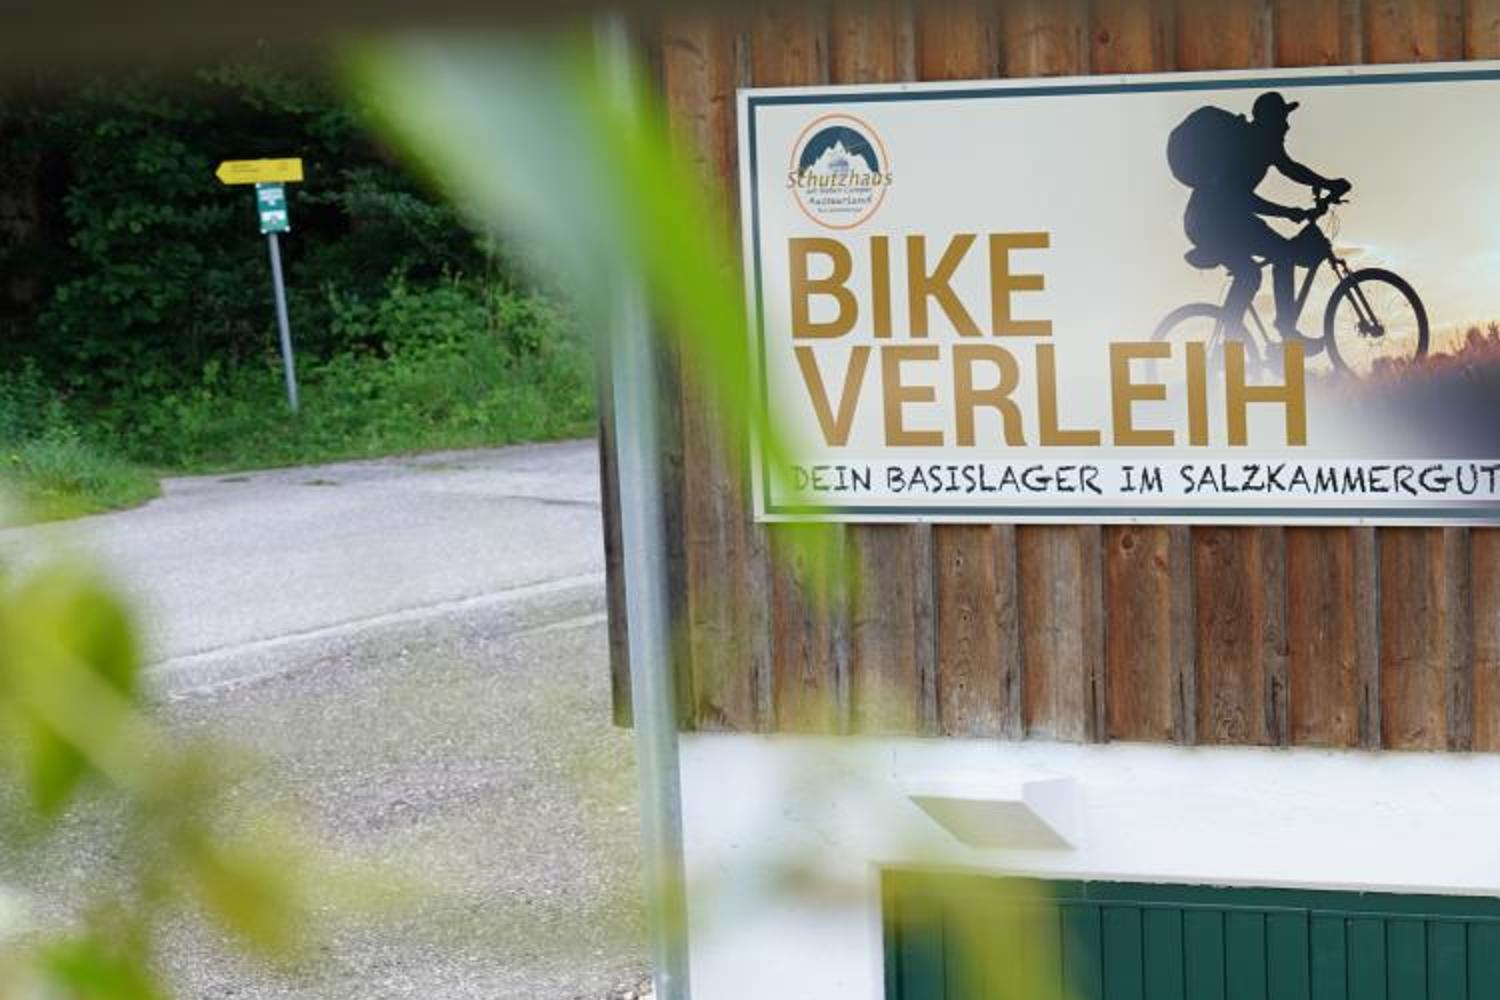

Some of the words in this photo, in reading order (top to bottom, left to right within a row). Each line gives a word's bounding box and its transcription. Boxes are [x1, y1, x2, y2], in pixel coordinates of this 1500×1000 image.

[788, 231, 1053, 339] BIKE
[793, 341, 1307, 447] VERLEIH
[886, 463, 1103, 495] BASISLAGER
[1119, 464, 1164, 495] IM
